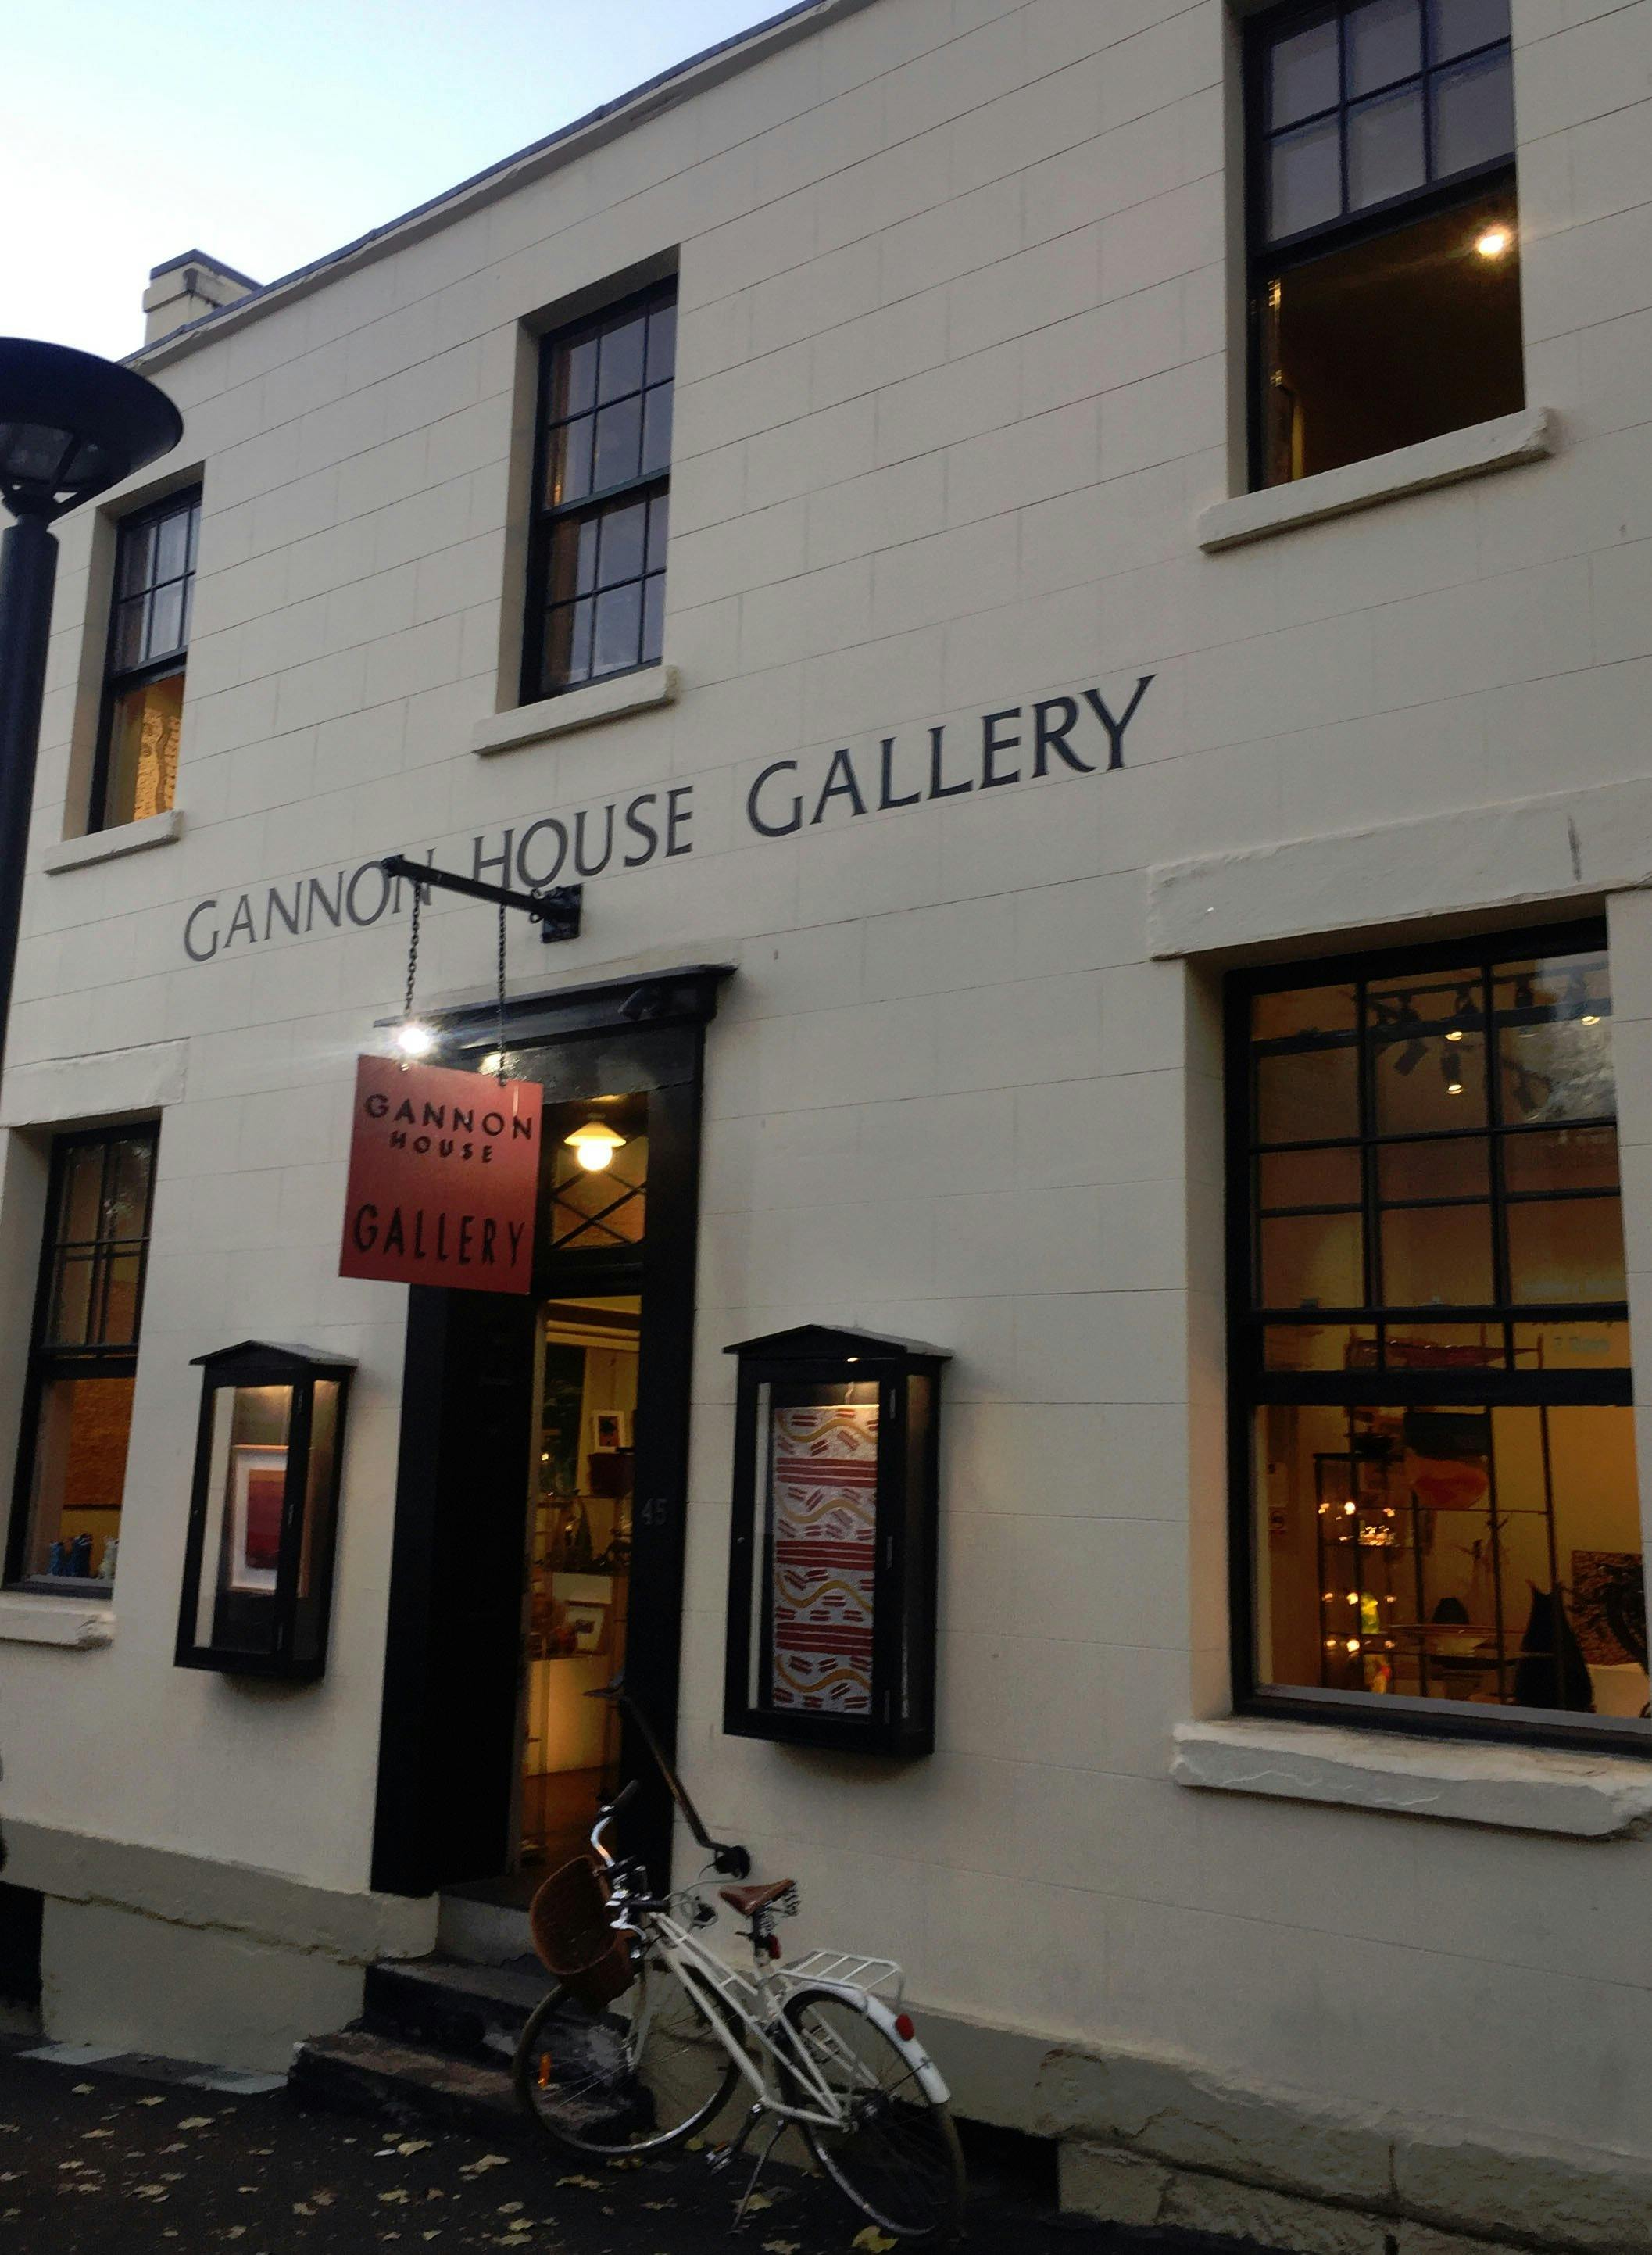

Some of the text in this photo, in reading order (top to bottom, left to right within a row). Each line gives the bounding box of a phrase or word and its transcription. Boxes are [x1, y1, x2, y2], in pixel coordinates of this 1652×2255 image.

[473, 785, 694, 889] HOUSE
[746, 673, 1158, 838] GALLERY
[364, 1093, 533, 1140] GANNON
[390, 1129, 494, 1164] HOUSE
[352, 1203, 526, 1267] GALLERY
